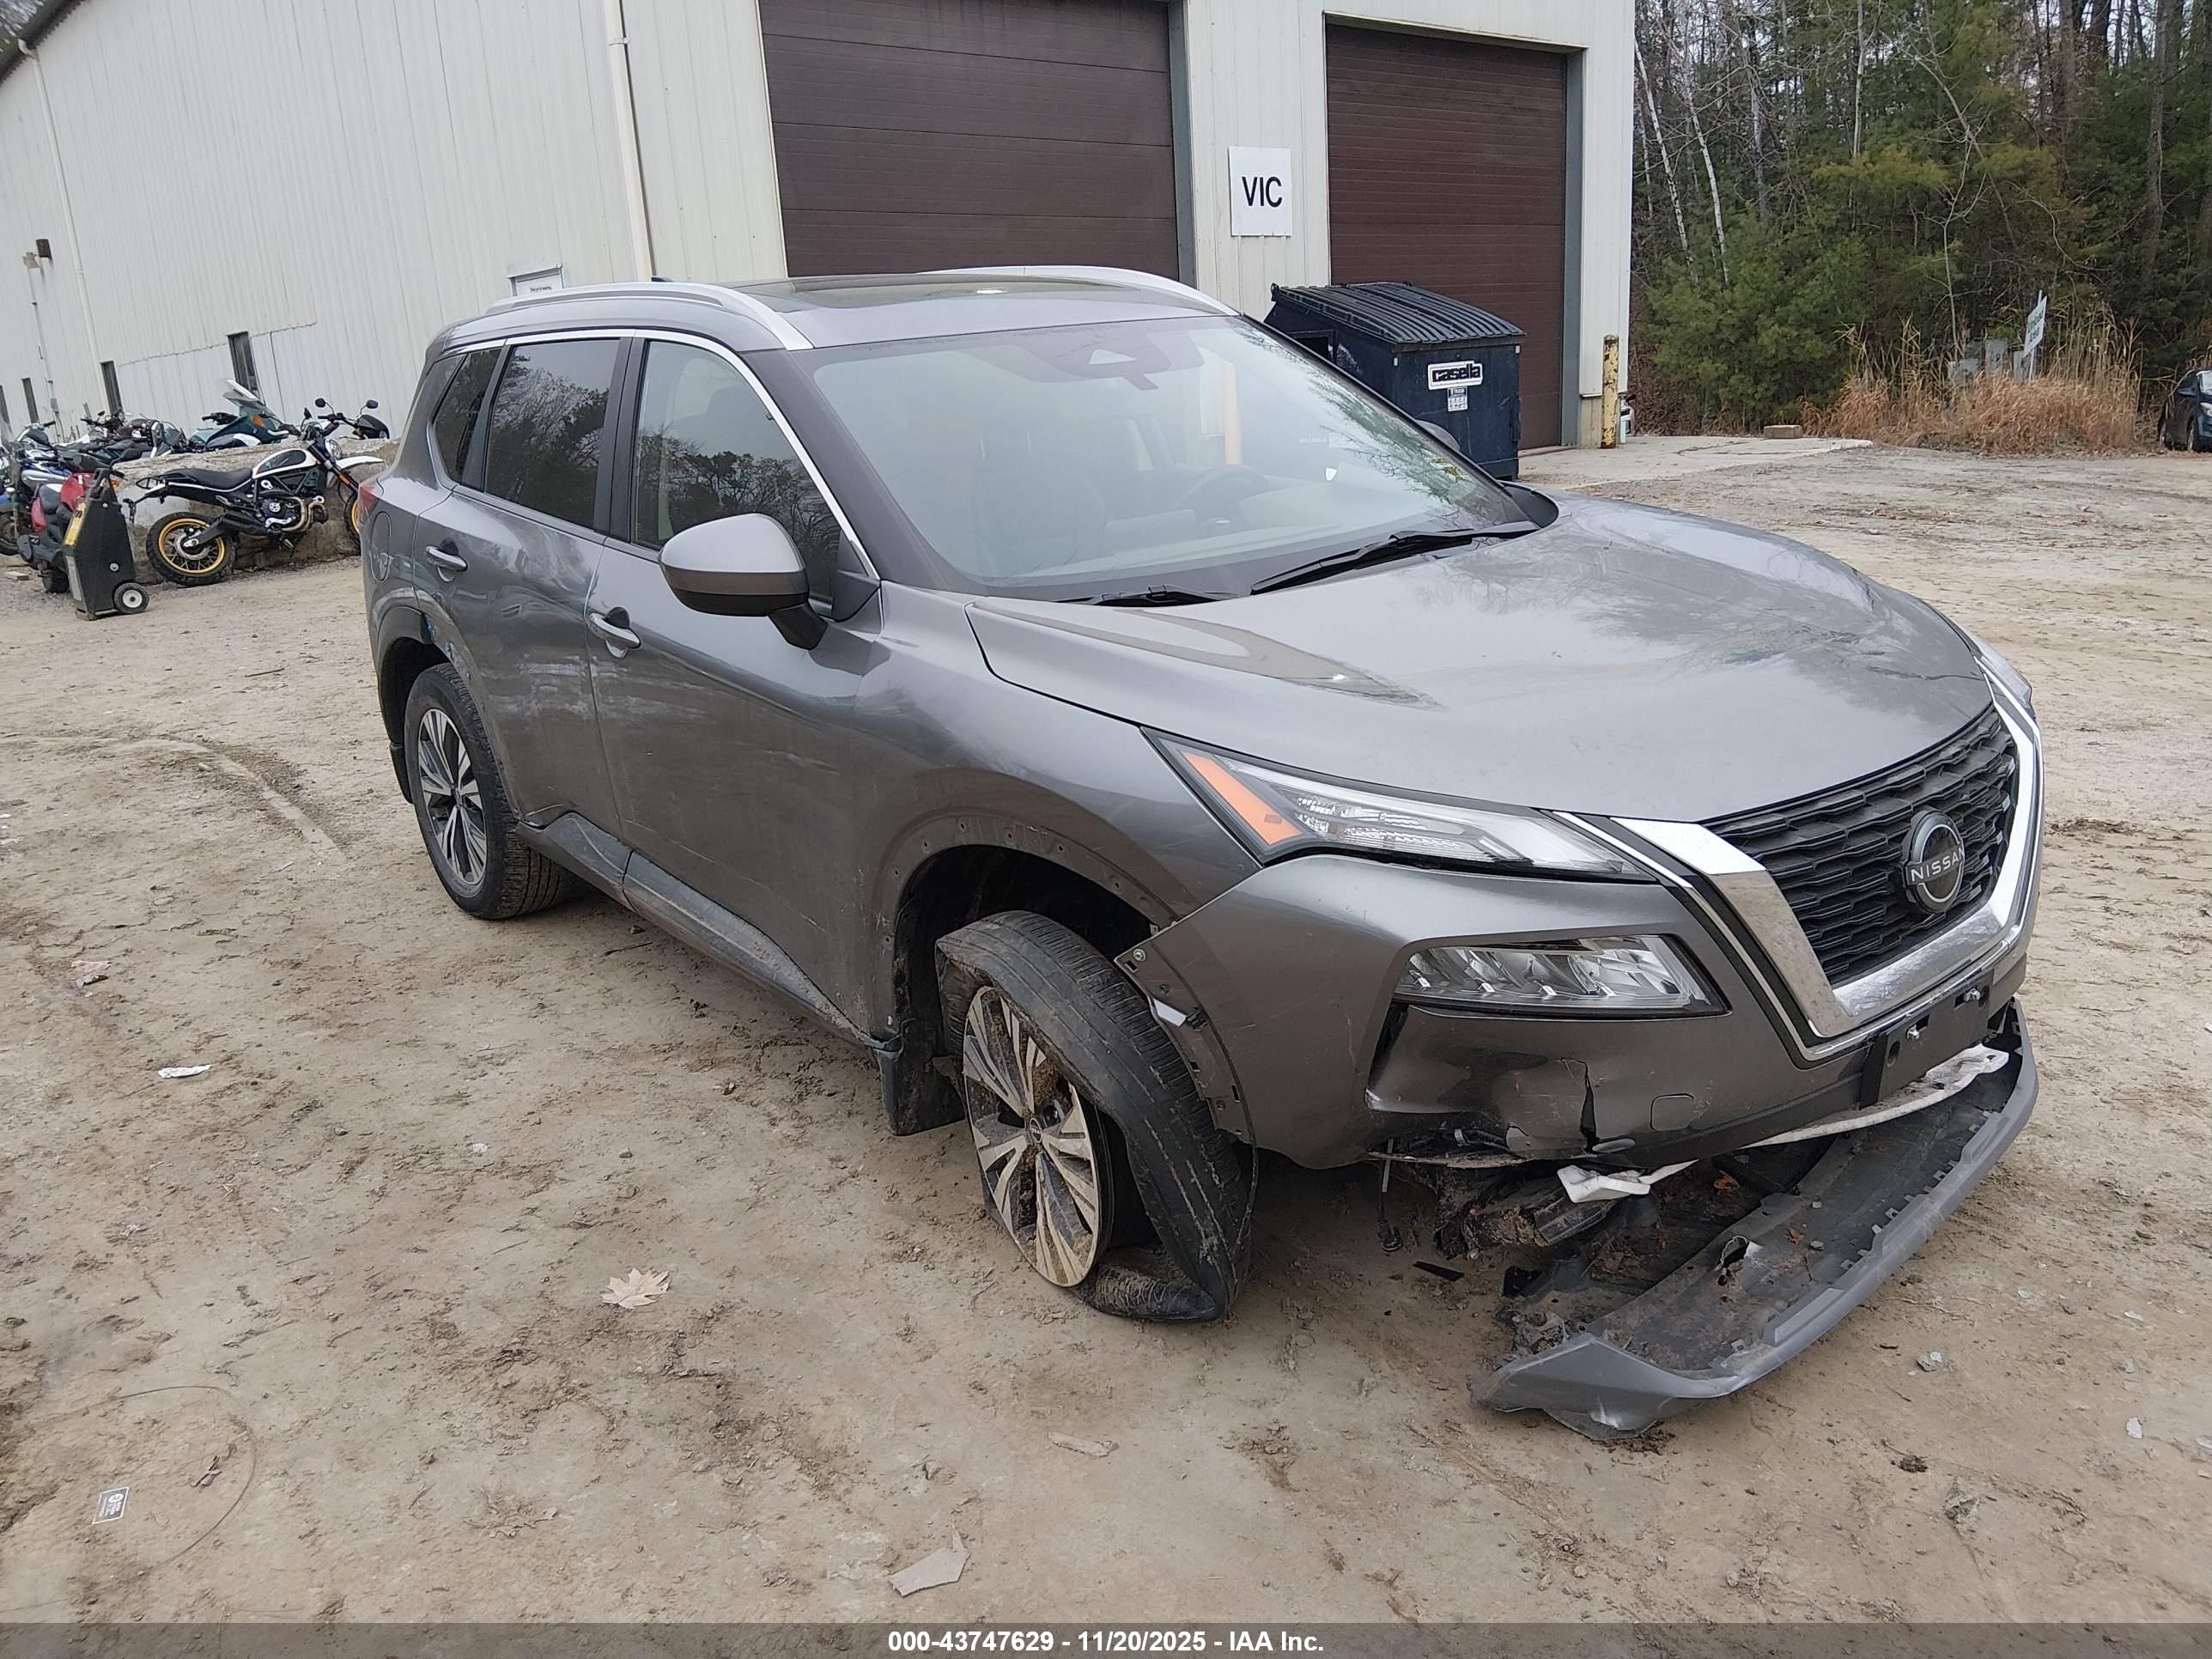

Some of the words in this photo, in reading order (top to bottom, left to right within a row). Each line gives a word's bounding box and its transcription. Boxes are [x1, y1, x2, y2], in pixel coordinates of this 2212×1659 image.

[1241, 176, 1283, 208] VIC
[1431, 362, 1481, 383] casella
[1911, 848, 1965, 882] NISSAN
